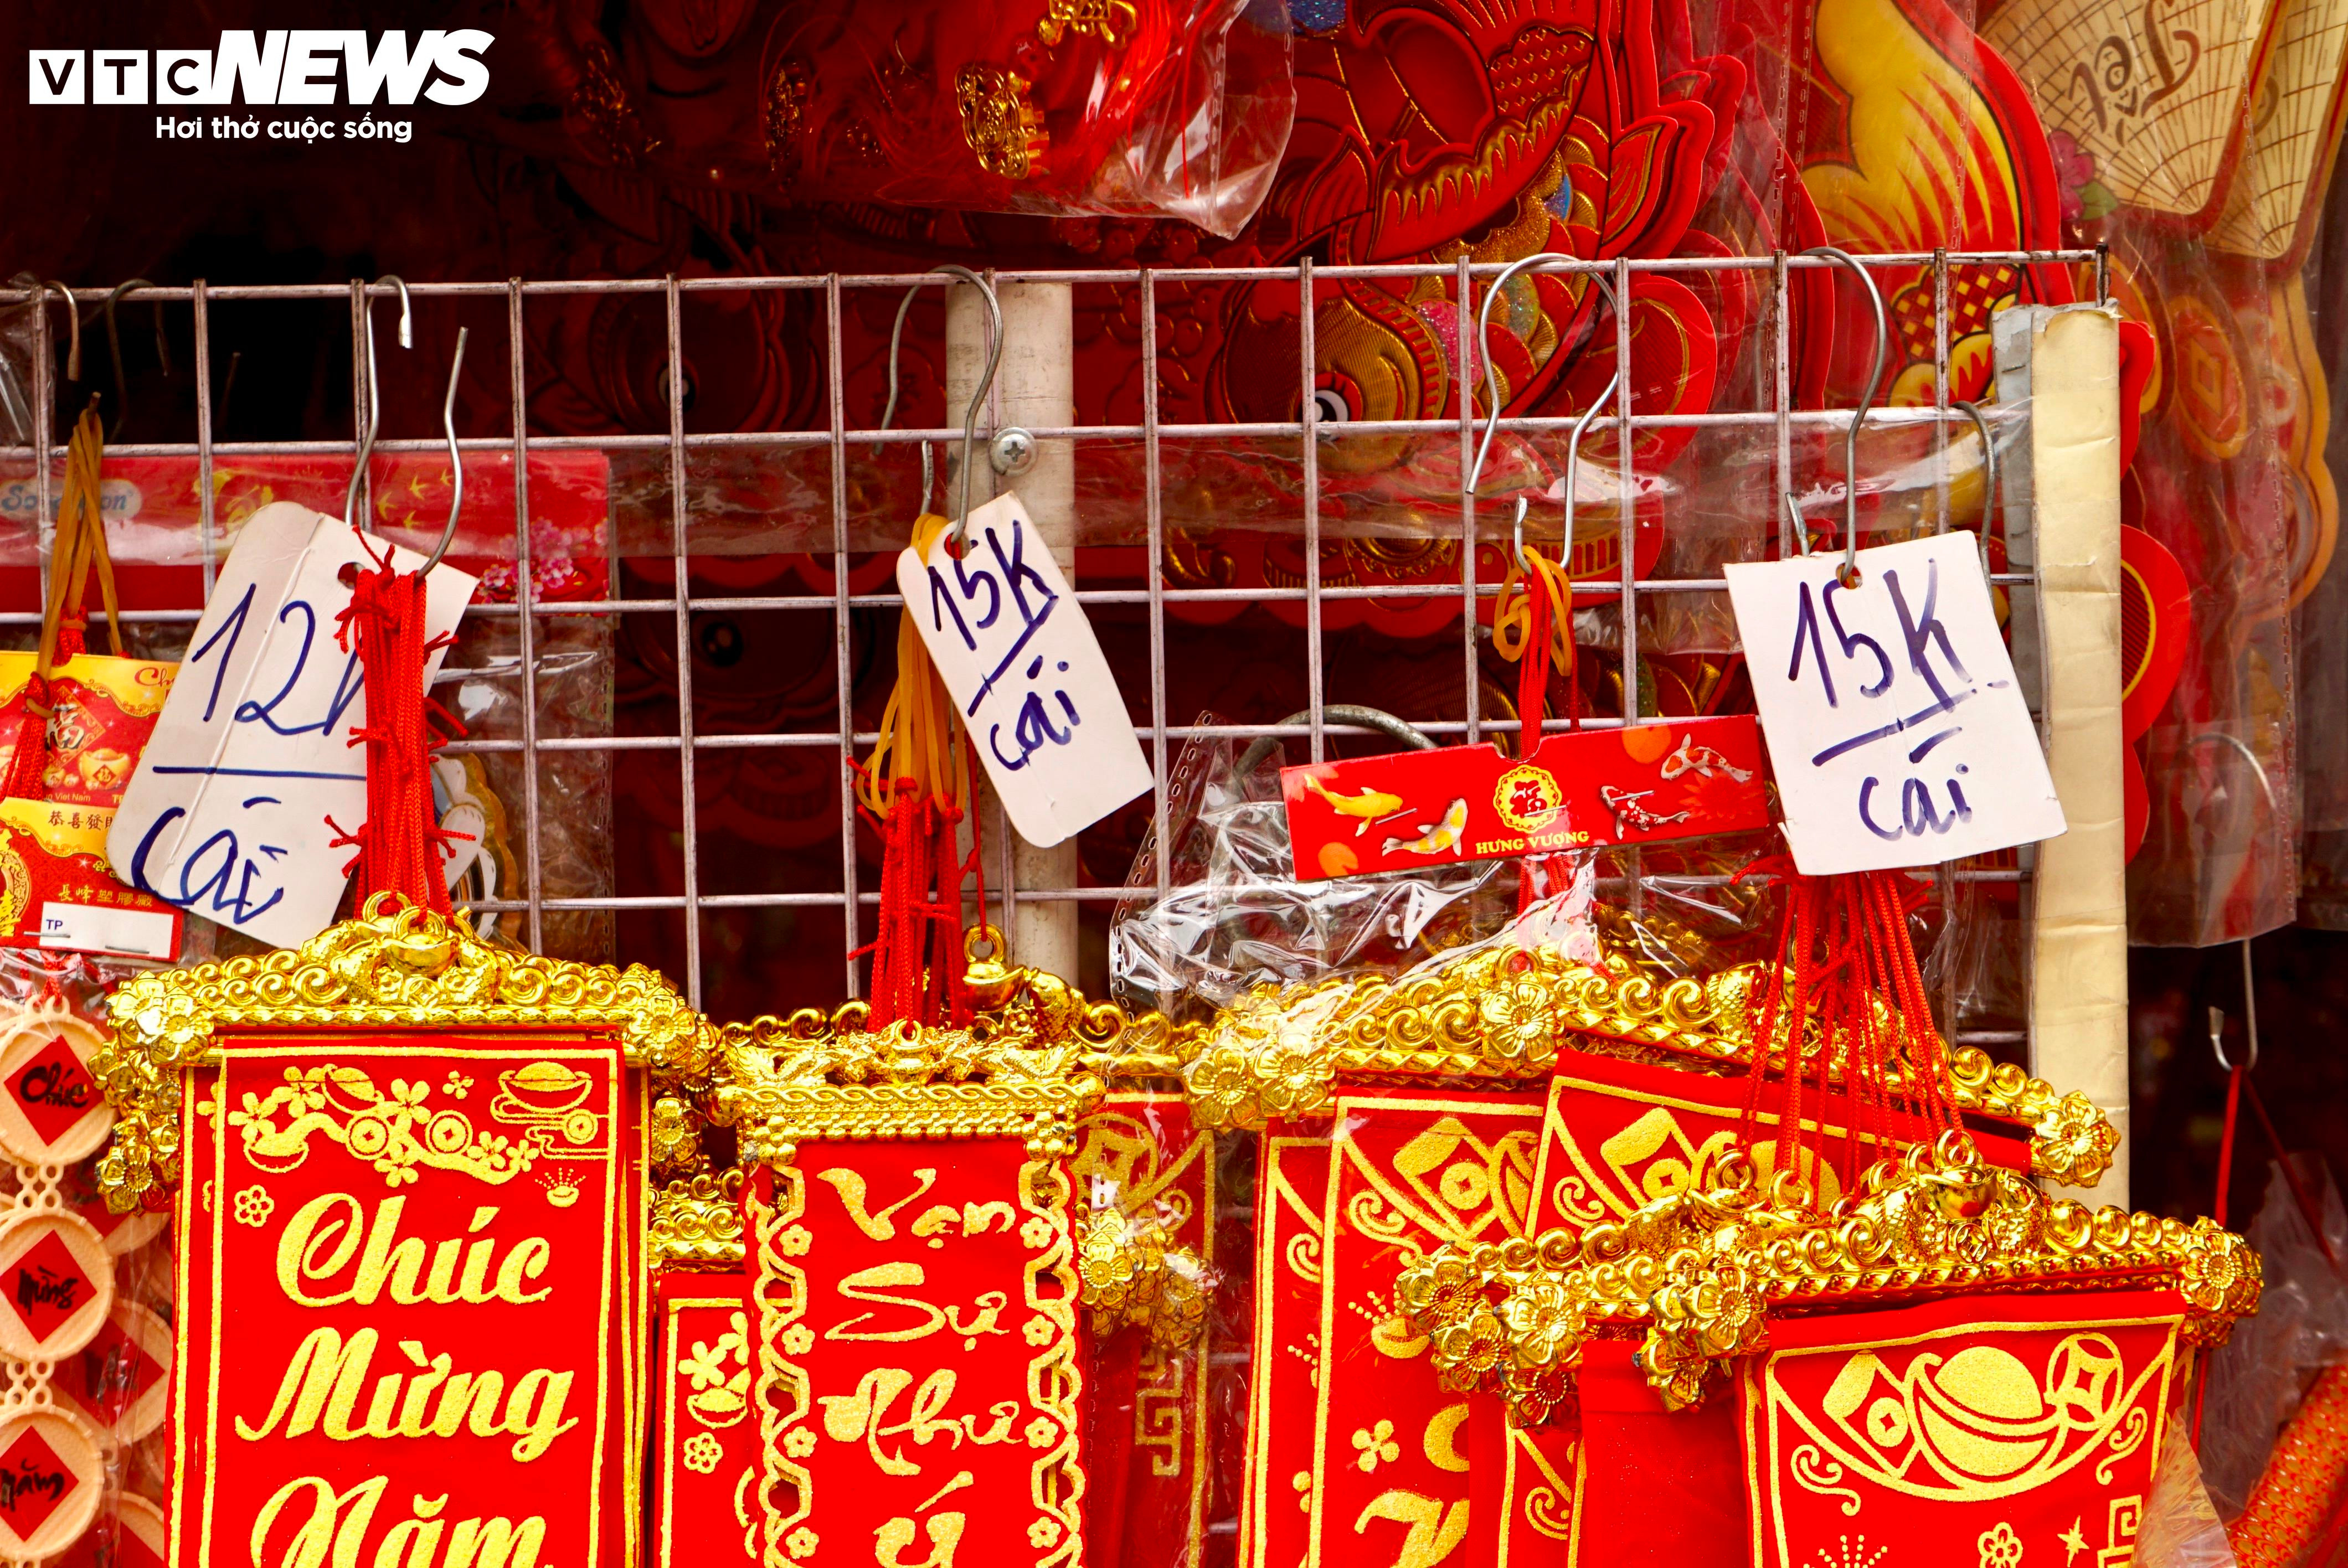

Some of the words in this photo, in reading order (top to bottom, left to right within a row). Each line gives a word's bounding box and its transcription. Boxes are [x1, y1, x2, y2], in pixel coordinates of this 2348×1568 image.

[990, 654, 1081, 771] cái
[72, 793, 91, 802] Nam
[1858, 726, 1973, 841] cái
[1475, 838, 1525, 854] HƯNG
[1527, 831, 1590, 848] VƯỢNG
[46, 919, 63, 930] TP
[276, 1192, 553, 1307] Chúc
[816, 1168, 1016, 1249] Vạn
[823, 1261, 1011, 1352] Sự
[234, 1326, 579, 1463] Mừng
[250, 1474, 554, 1568] Năm
